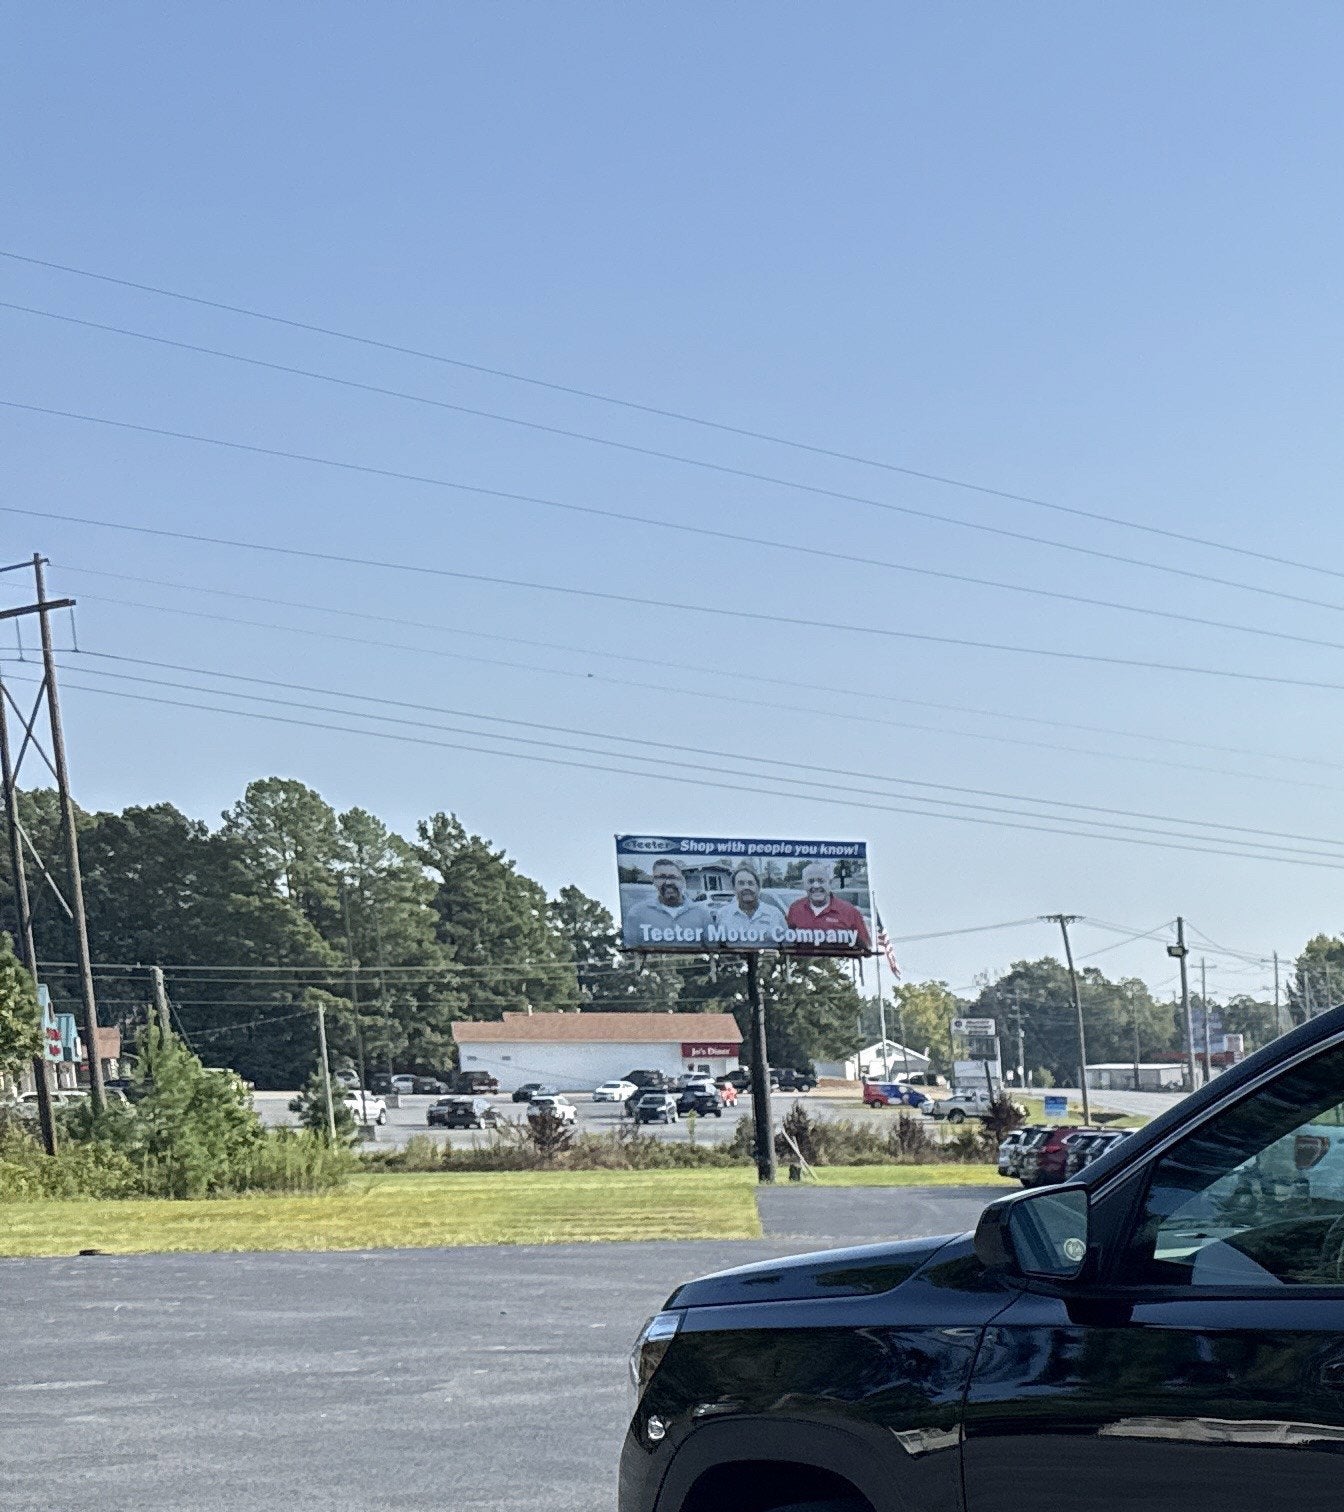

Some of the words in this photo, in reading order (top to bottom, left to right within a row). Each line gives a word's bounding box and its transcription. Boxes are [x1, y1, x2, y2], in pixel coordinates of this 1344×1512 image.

[680, 839, 715, 854] Shop
[717, 841, 745, 853] with
[747, 842, 793, 855] people
[795, 844, 818, 856] you
[820, 844, 859, 856] know!
[640, 924, 703, 942] Teeter
[707, 924, 766, 942] Motor
[771, 926, 858, 946] Company
[707, 1047, 731, 1056] Diner
